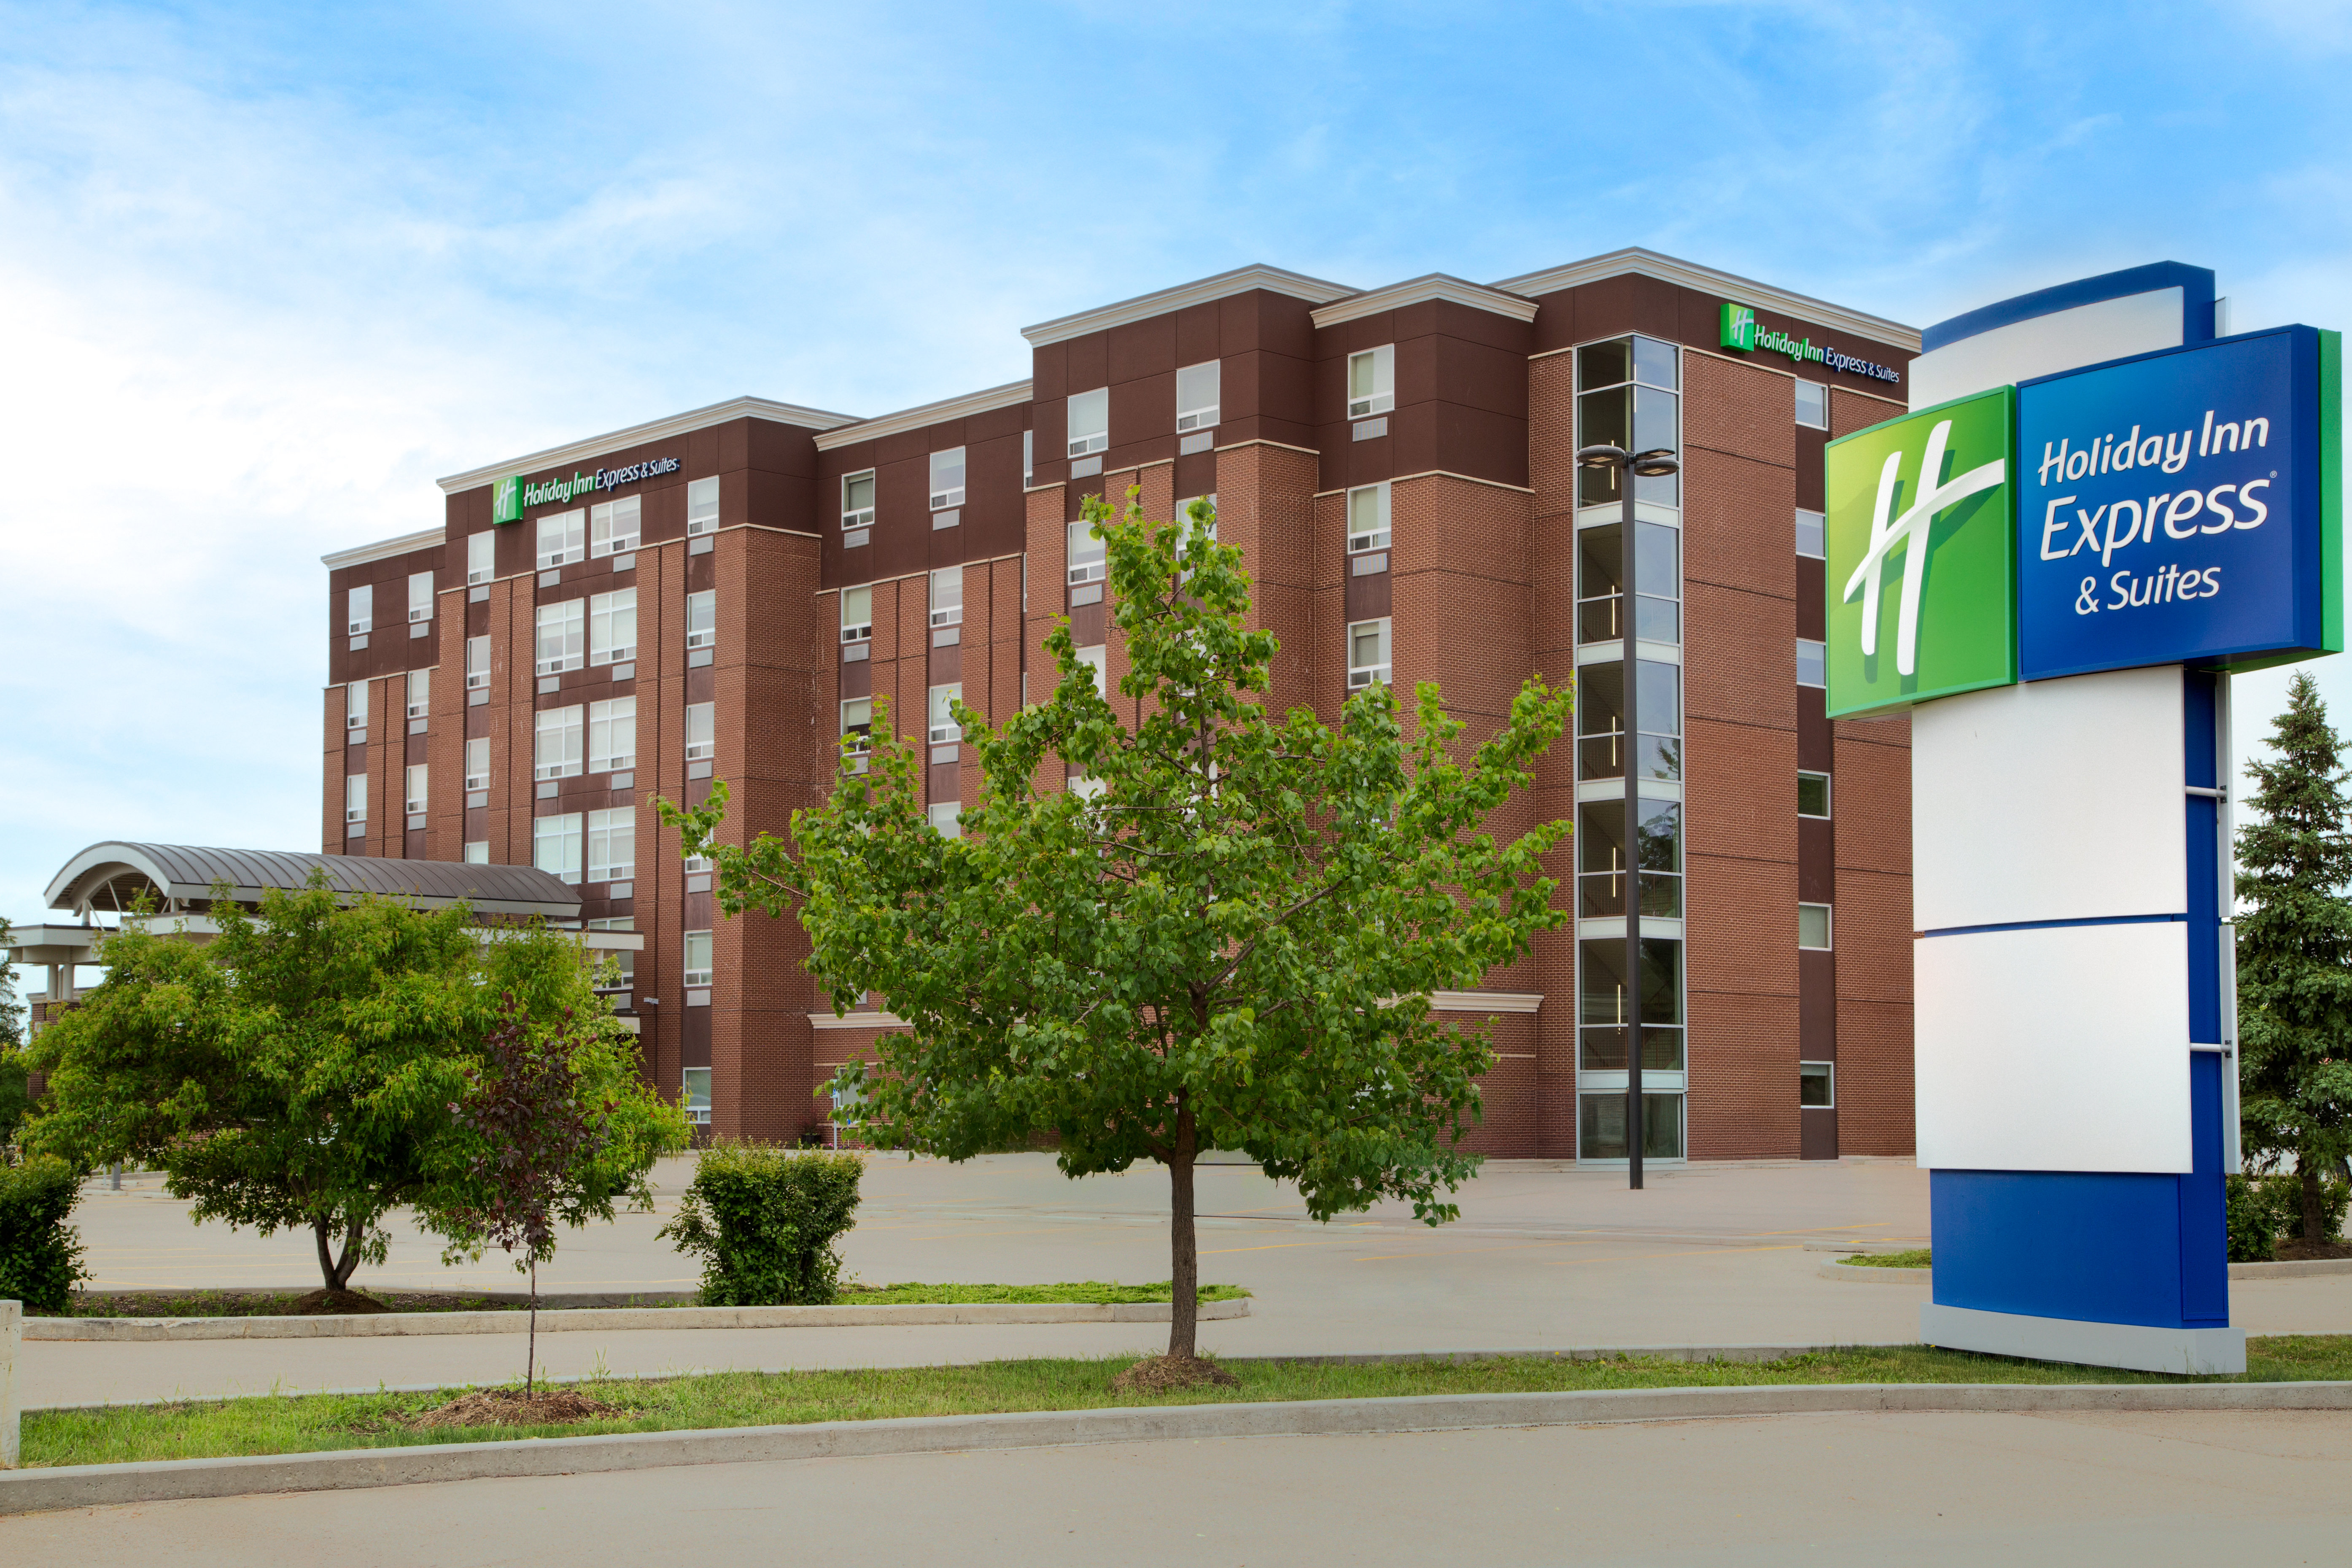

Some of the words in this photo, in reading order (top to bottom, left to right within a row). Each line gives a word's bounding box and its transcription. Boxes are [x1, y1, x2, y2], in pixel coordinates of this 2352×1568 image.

[1754, 324, 1803, 361] Holiday
[1805, 338, 1824, 363] Inn
[1826, 346, 1867, 372] Express
[1868, 362, 1875, 376] &
[1875, 364, 1899, 383] Suites
[2038, 425, 2192, 486] Holiday
[2199, 410, 2269, 457] Inn
[523, 478, 572, 507] Holiday
[573, 471, 593, 496] Inn
[595, 464, 639, 492] Express
[641, 462, 648, 478] &
[649, 457, 677, 476] Suites
[2075, 576, 2100, 615] &
[2107, 564, 2221, 610] Suites
